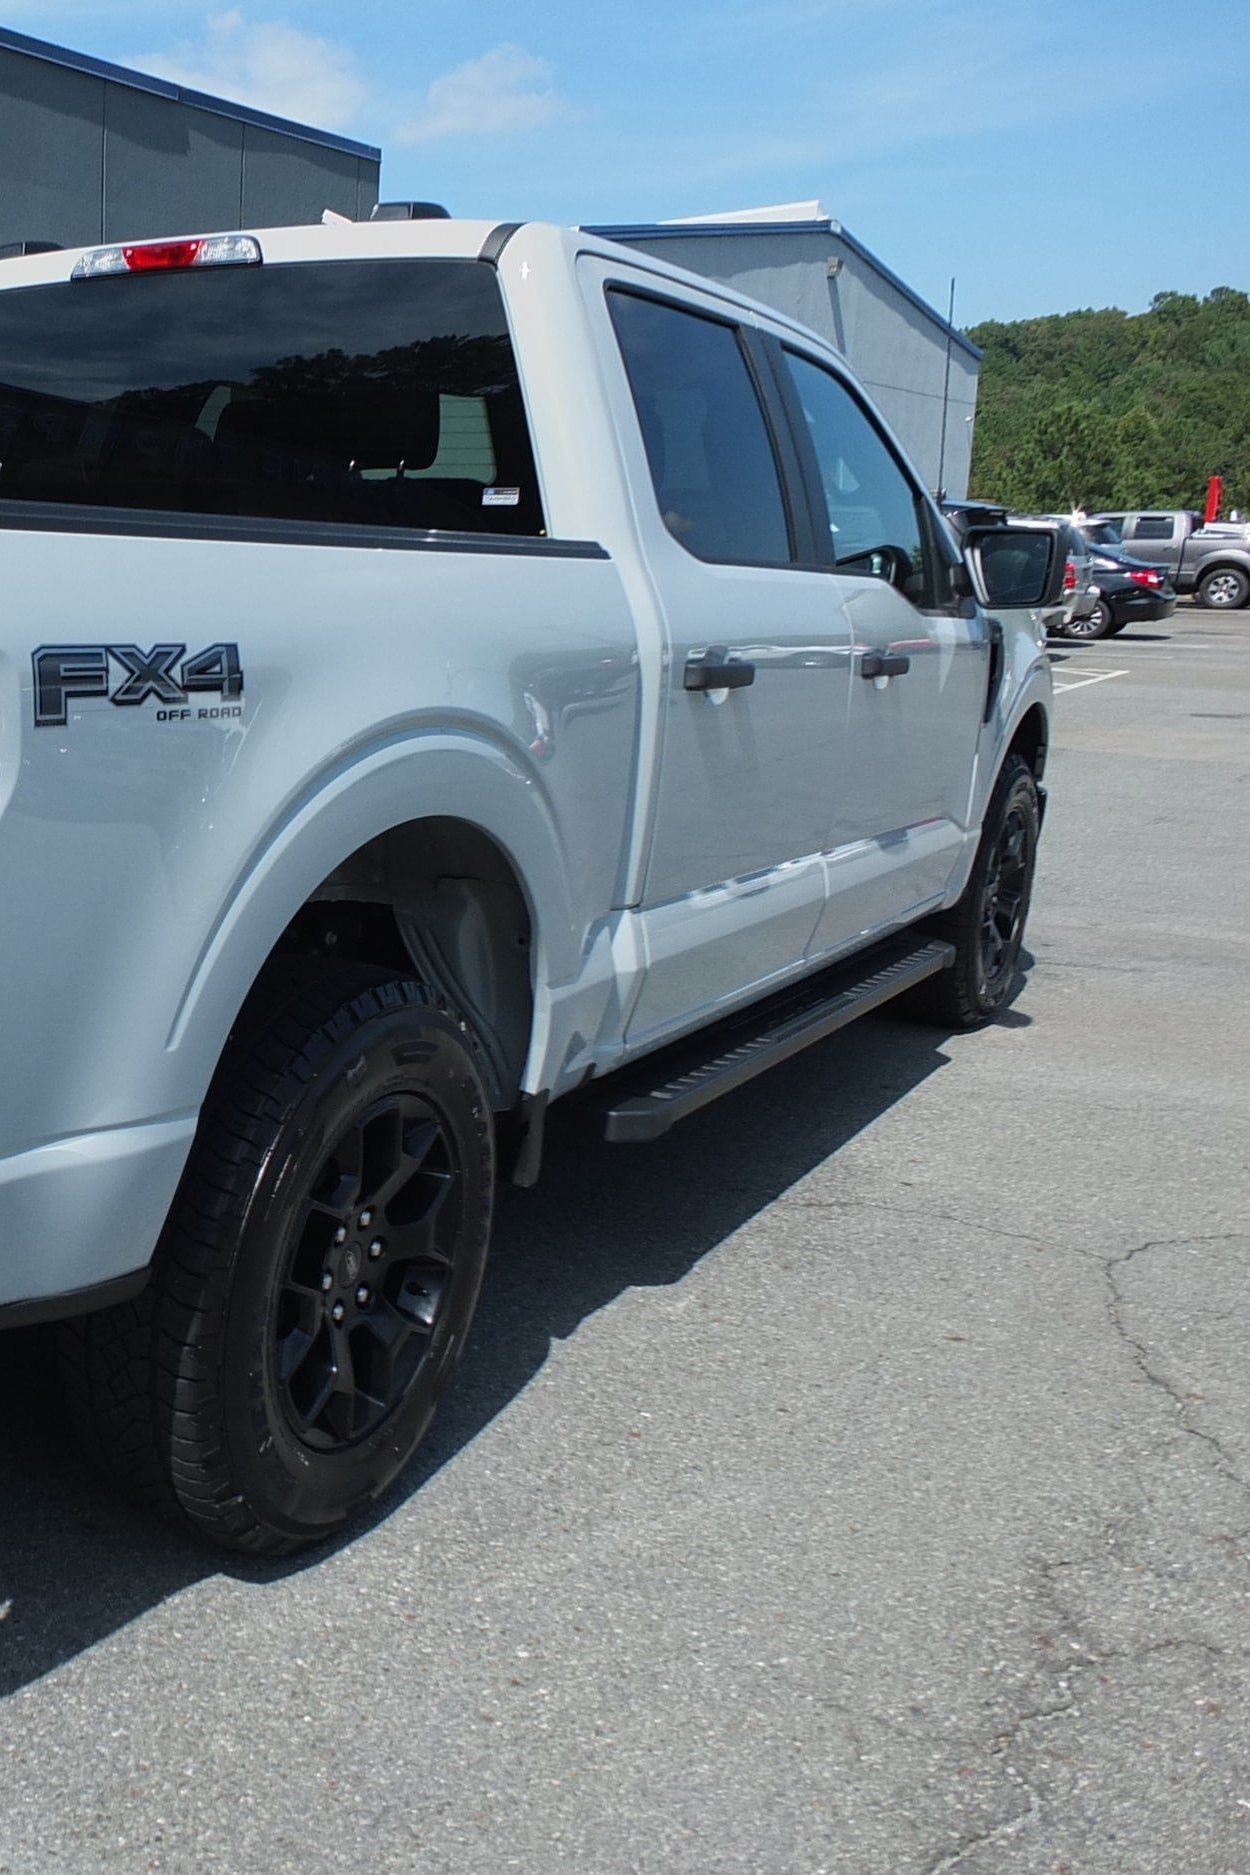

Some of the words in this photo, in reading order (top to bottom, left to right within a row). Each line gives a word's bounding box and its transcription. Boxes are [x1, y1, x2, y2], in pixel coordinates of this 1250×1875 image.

[31, 642, 244, 727] FX4
[156, 709, 191, 722] OFF
[197, 706, 242, 720] ROAD
